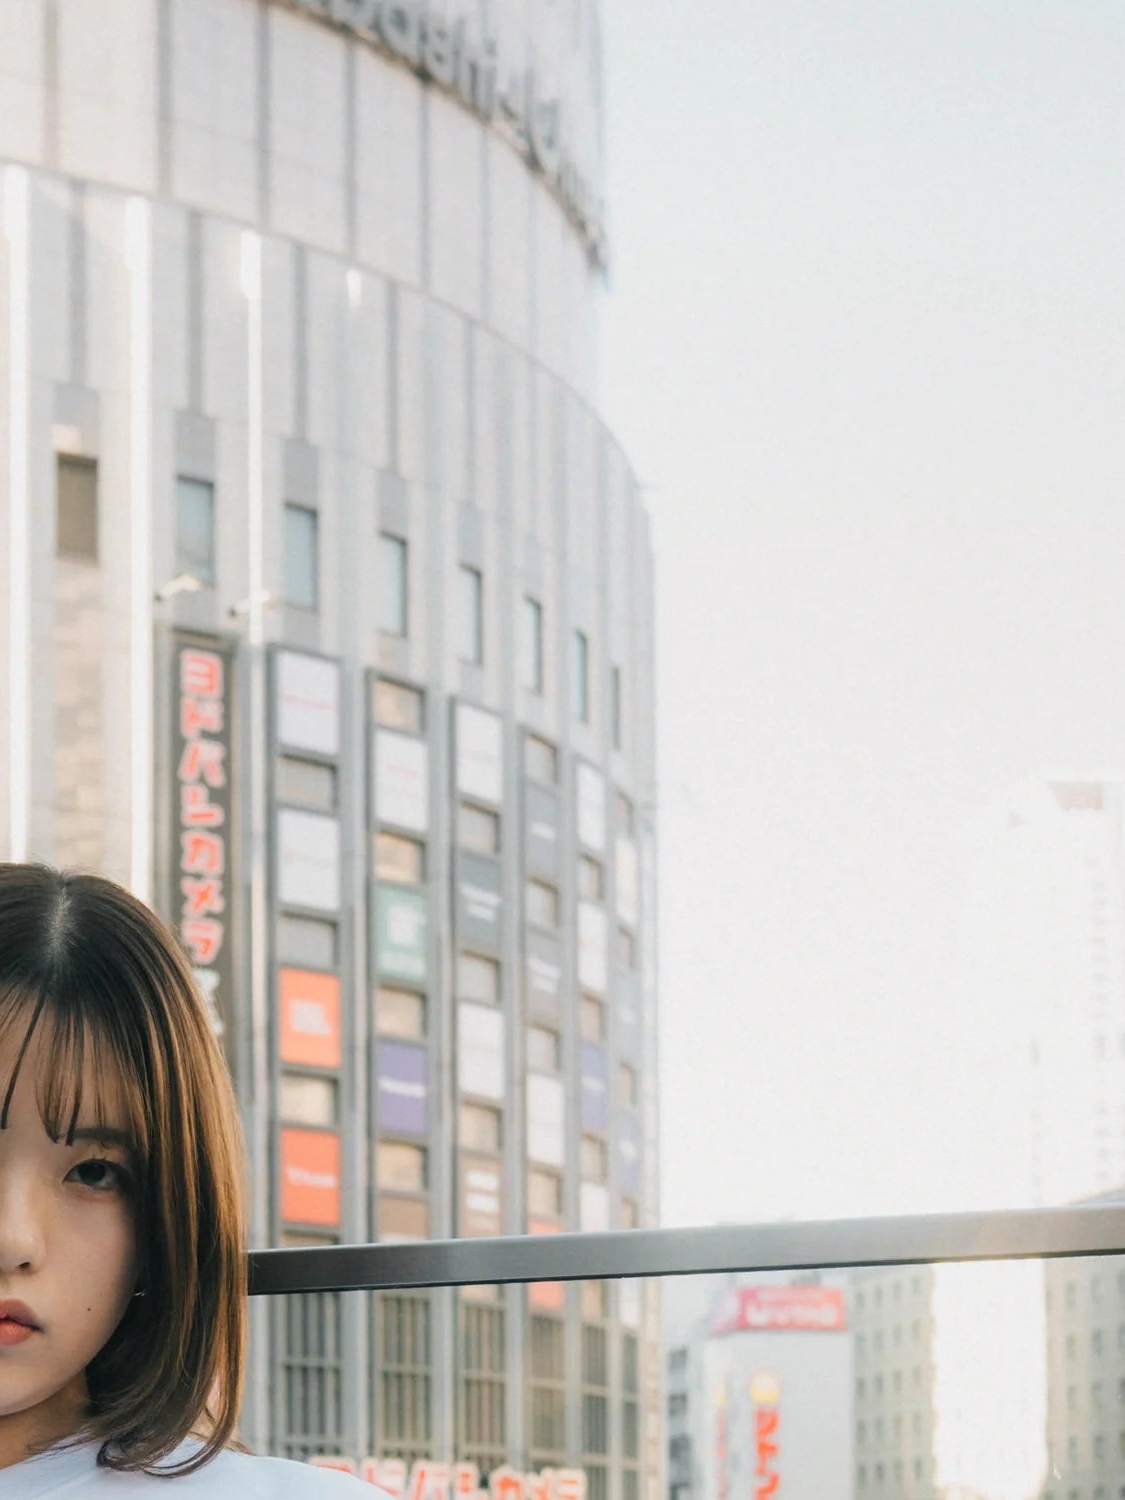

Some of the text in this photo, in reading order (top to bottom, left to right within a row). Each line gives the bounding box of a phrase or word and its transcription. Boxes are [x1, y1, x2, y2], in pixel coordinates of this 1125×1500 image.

[178, 650, 225, 966] ヨドバシカメラ
